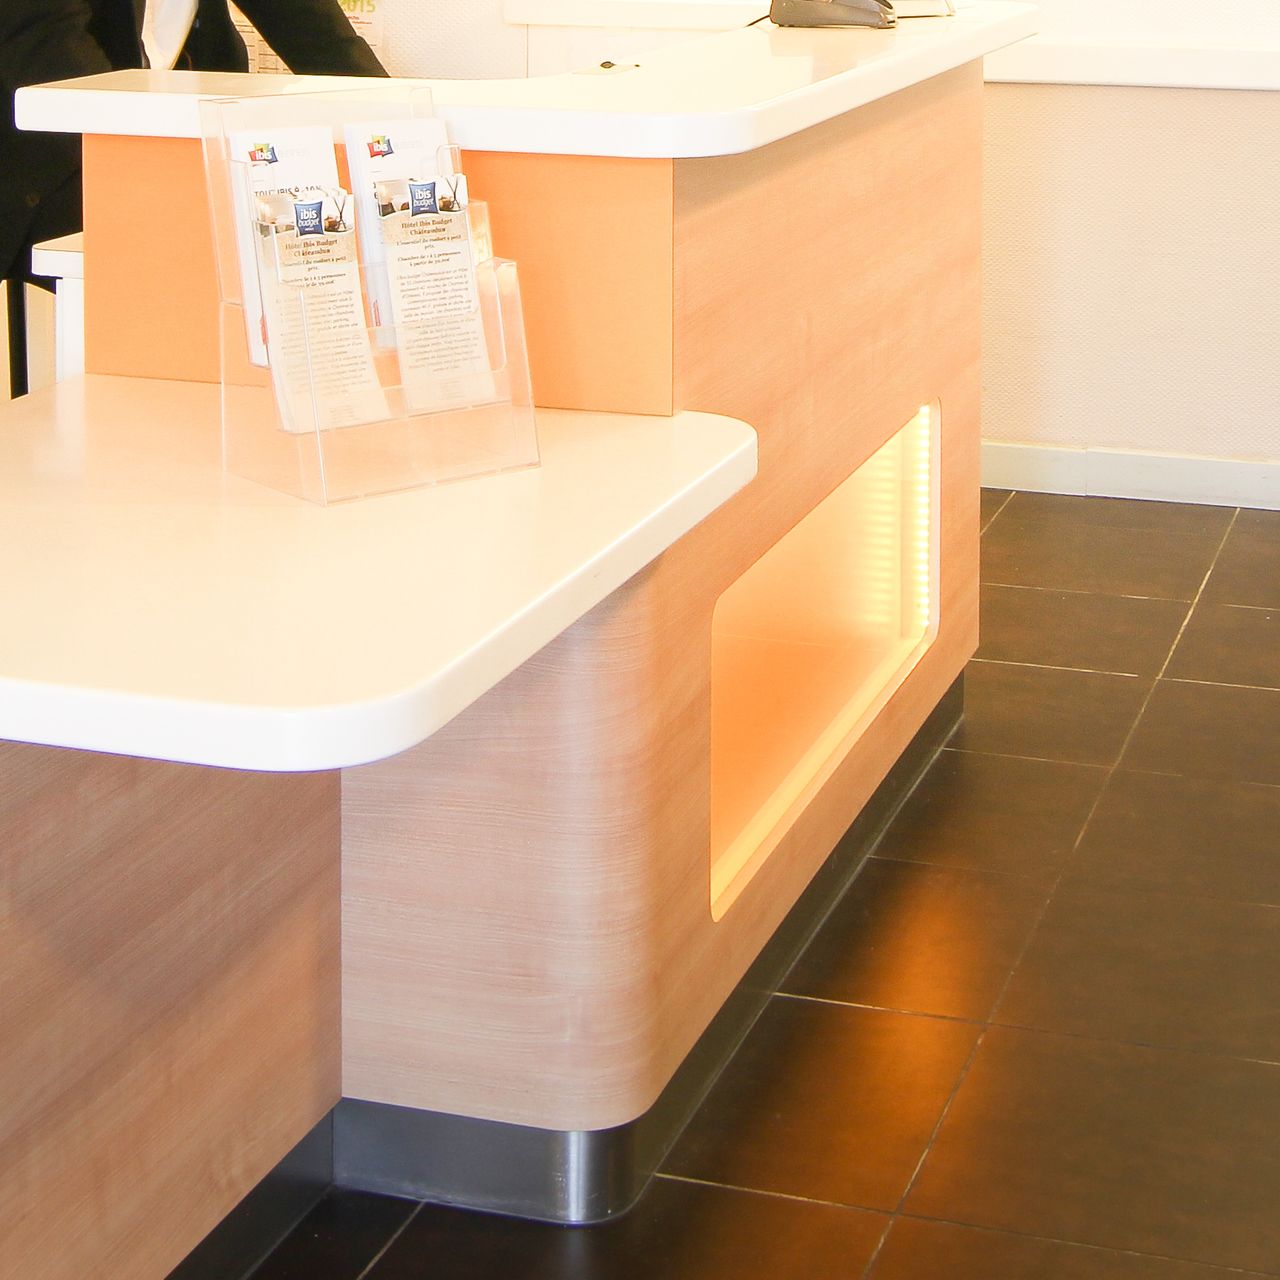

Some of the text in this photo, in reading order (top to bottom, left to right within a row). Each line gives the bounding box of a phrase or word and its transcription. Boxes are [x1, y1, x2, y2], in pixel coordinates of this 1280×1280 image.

[373, 142, 388, 152] ibis
[256, 150, 273, 160] ibis
[416, 188, 432, 200] ibis
[414, 198, 434, 208] budget
[300, 208, 318, 220] ibis
[298, 218, 320, 228] budget
[402, 221, 419, 229] Hôtel
[432, 218, 453, 226] Budget
[303, 240, 315, 248] Ibis
[317, 238, 338, 247] Budget
